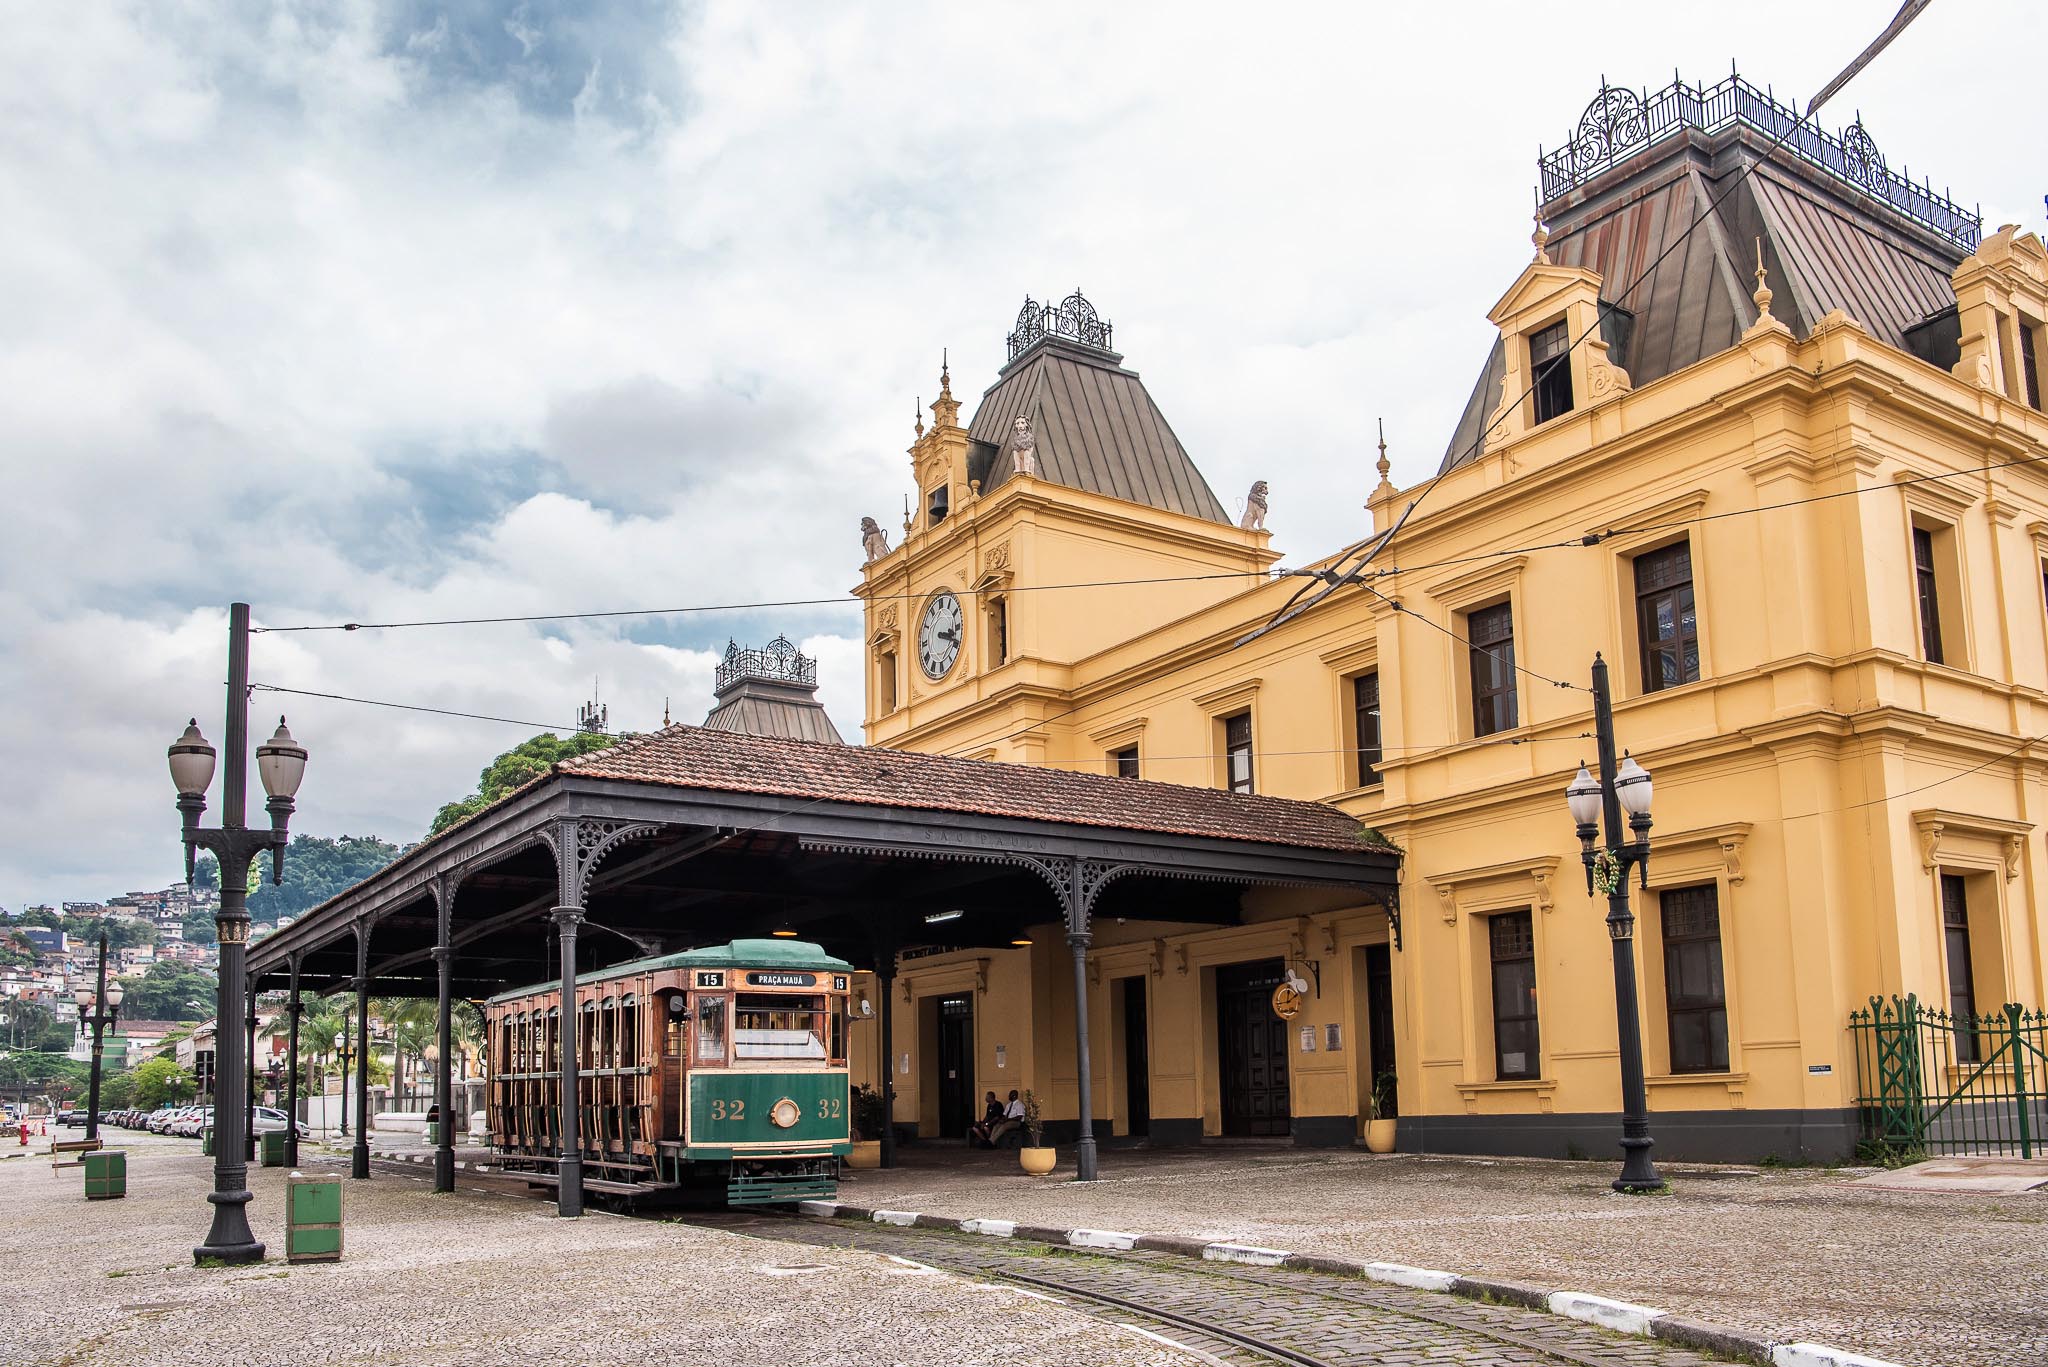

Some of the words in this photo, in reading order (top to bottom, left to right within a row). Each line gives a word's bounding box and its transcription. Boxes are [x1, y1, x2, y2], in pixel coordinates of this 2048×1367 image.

[981, 834, 1047, 850] PAULO
[703, 974, 718, 986] 15
[758, 975, 782, 986] PRAÇA
[782, 975, 803, 985] MAUÁ
[835, 978, 844, 990] 15
[711, 1100, 745, 1120] 32
[818, 1098, 840, 1119] 32
